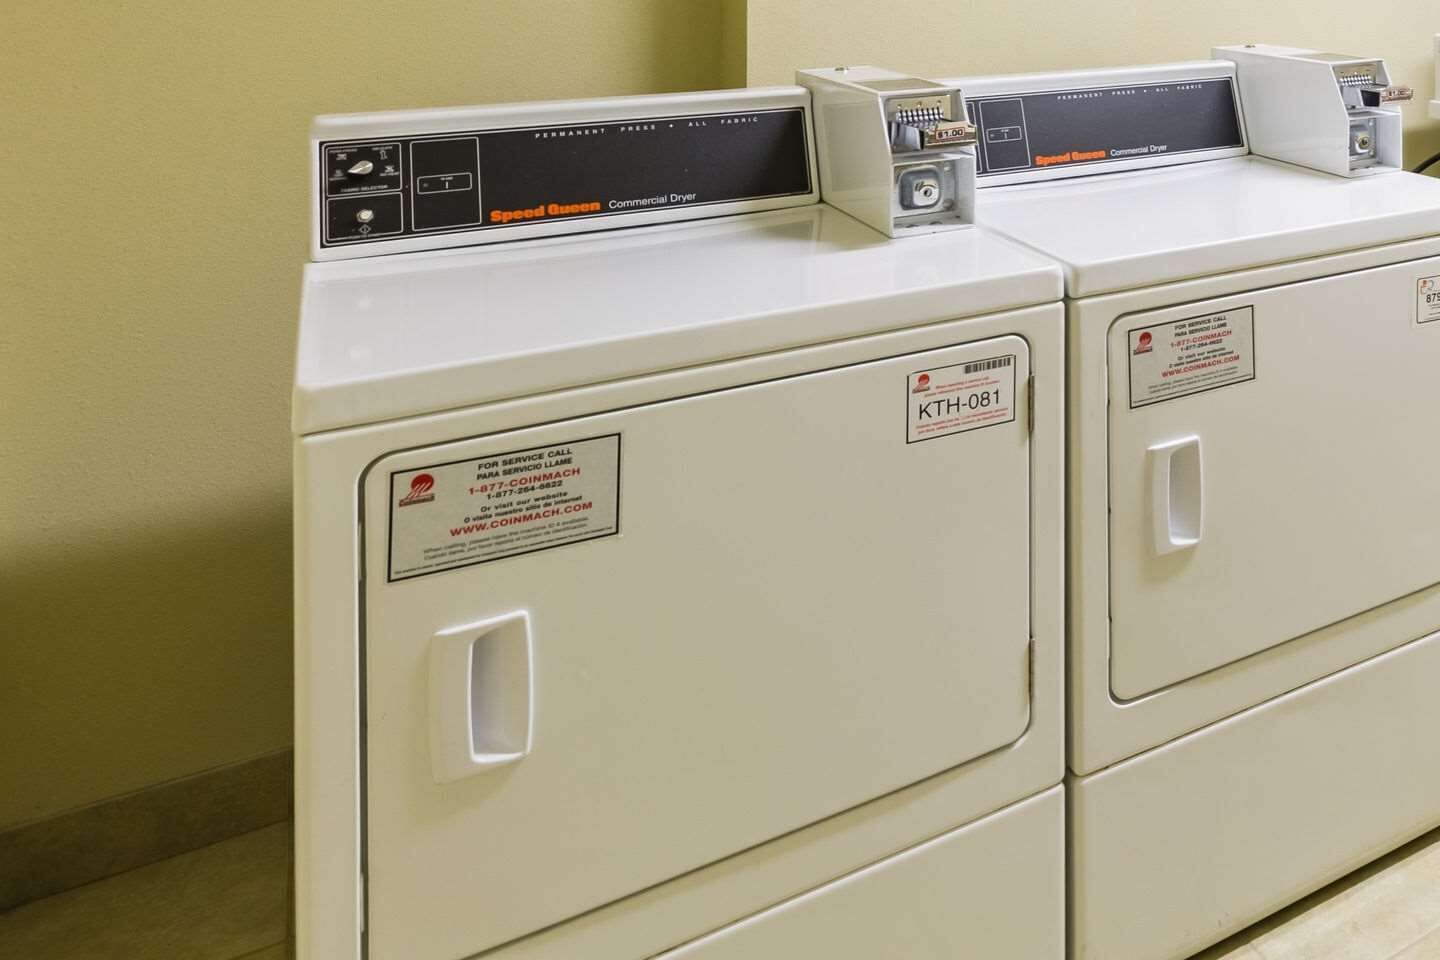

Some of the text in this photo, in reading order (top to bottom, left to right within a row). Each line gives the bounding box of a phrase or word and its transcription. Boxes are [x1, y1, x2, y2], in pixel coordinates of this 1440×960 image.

[535, 116, 759, 139] PERMANENT PRESS ALL FABRIC
[937, 128, 963, 139] $1.00
[1110, 144, 1167, 157] Commercial Dryer
[490, 201, 601, 223] Speed Queen
[608, 192, 698, 209] Commercial Dryer
[919, 388, 1000, 421] KTH-081
[476, 457, 573, 480] PARA SERVICIO LLAME
[478, 448, 573, 471] FOR SERVICE CALL
[468, 468, 581, 495] 1-877-COINMACH
[480, 505, 492, 513] Or
[494, 501, 513, 511] visit
[516, 499, 531, 507] our
[449, 501, 593, 537] WWW.COINMACH.COM
